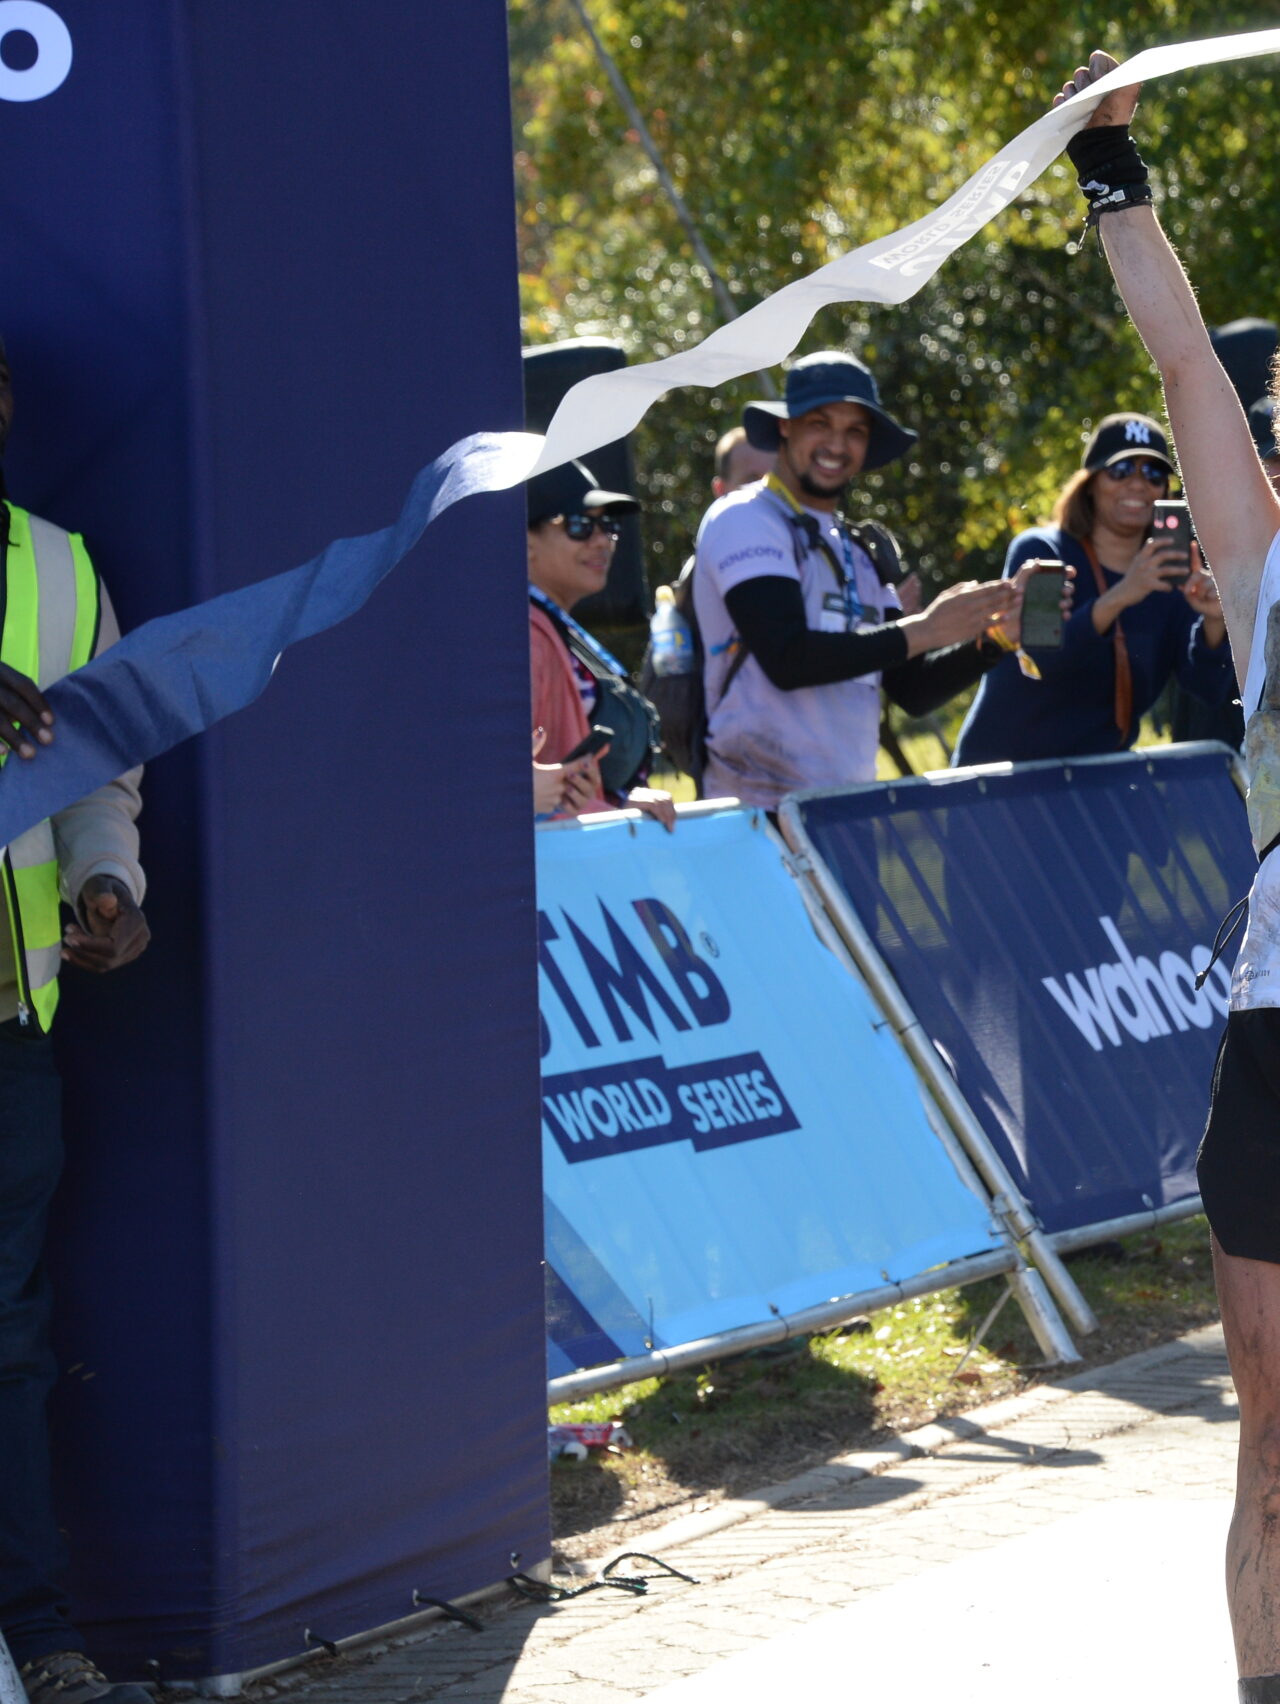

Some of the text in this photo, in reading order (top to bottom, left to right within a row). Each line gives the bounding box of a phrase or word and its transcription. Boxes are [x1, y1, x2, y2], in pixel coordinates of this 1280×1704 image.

[538, 894, 732, 1060] TMB
[1041, 915, 1232, 1052] wahoo
[543, 1070, 783, 1144] WORLD SERIES
